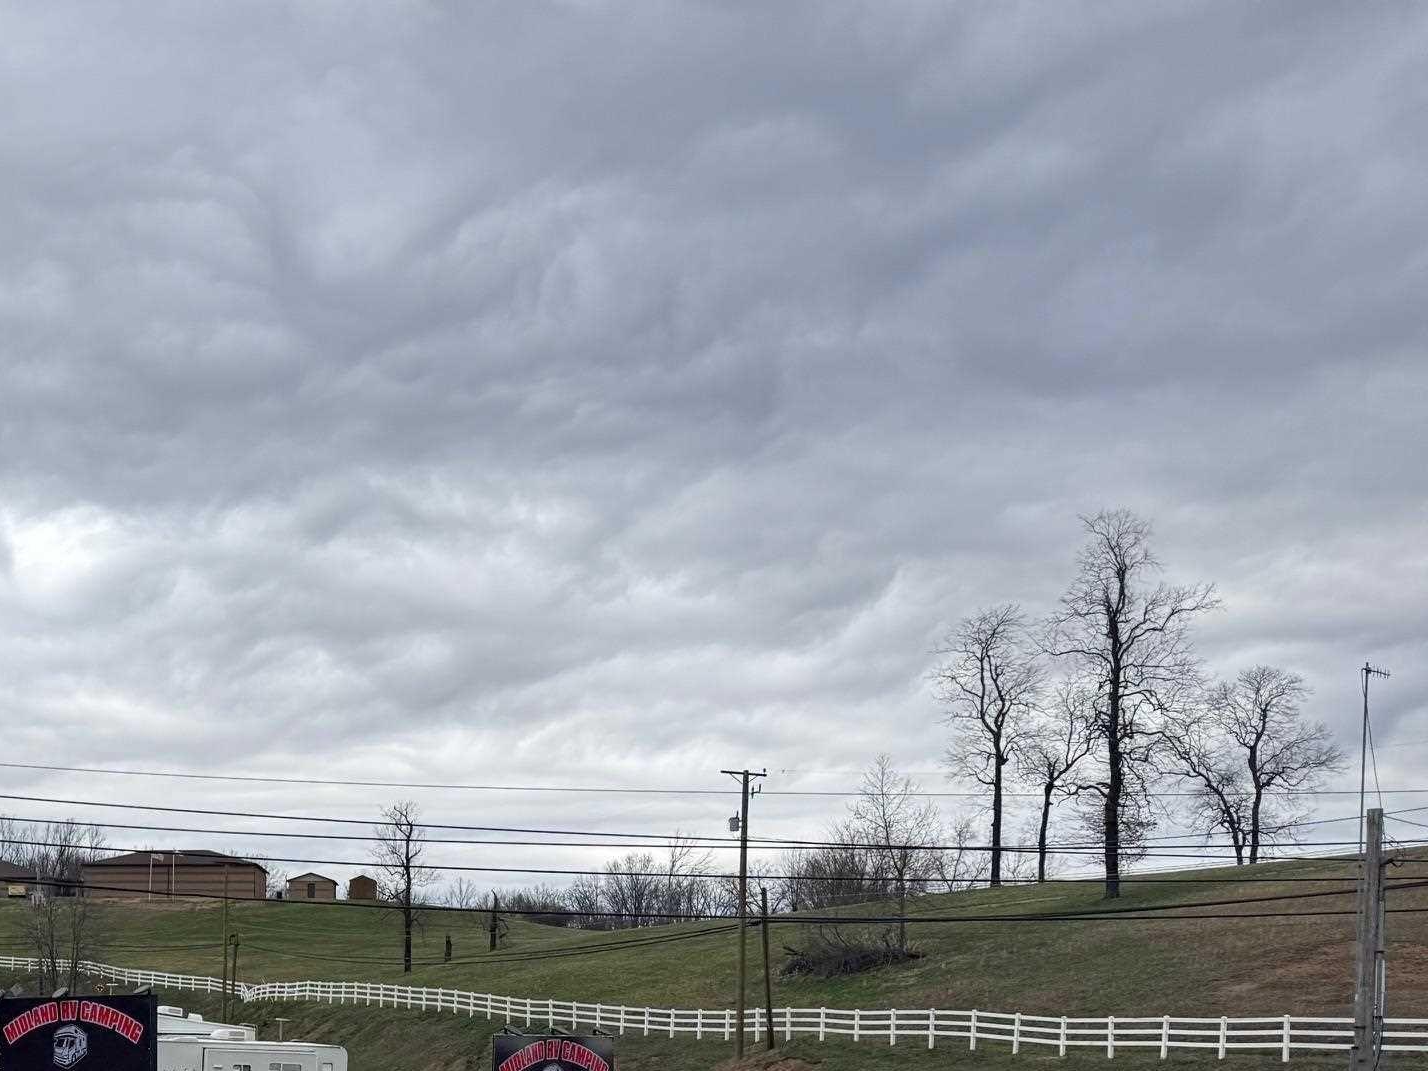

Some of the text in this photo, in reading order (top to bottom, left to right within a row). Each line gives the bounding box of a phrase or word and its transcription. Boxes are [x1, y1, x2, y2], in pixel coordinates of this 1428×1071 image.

[3, 1000, 144, 1045] MIDLAND RV CAMPING
[546, 1039, 561, 1060] RV
